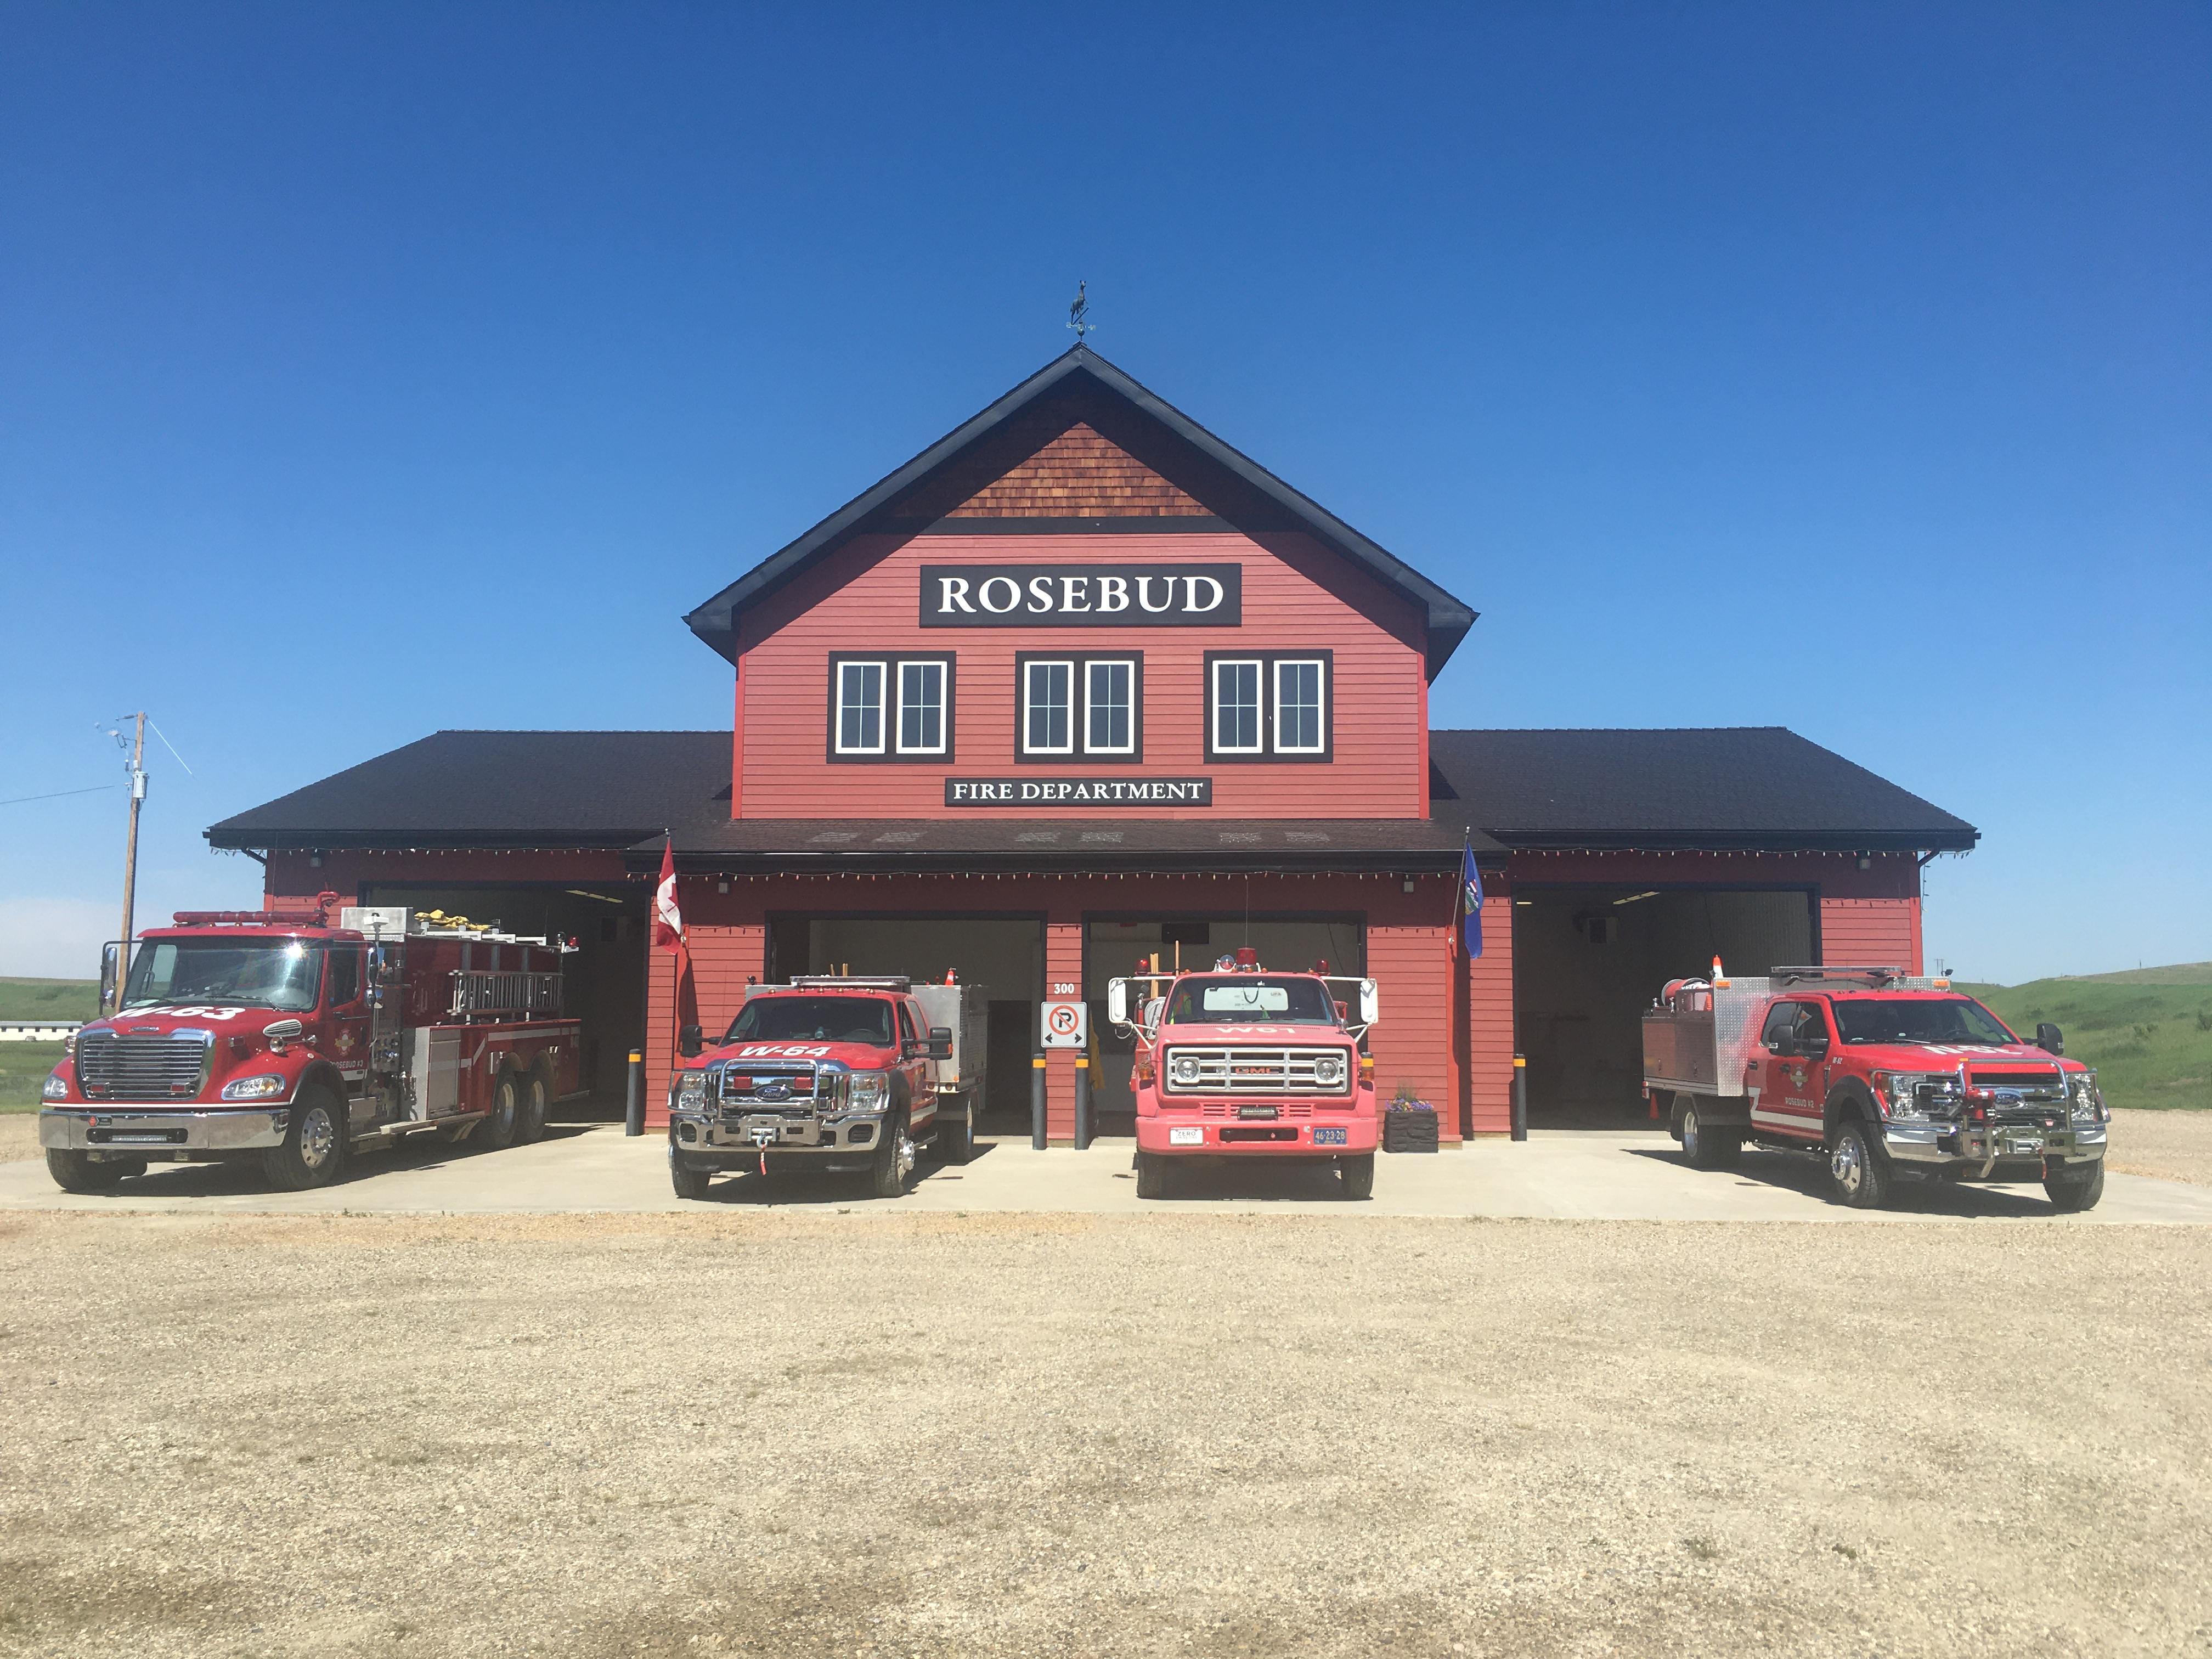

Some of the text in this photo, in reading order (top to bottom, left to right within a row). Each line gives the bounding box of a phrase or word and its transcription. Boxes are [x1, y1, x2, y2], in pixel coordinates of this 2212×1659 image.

[937, 576, 1223, 613] ROSEBUD
[953, 782, 1203, 799] FIRE DEPARTMENT
[1054, 983, 1074, 994] 300
[108, 1006, 246, 1020] W-63
[739, 1046, 832, 1057] W-64
[763, 1088, 782, 1097] Ford
[1785, 1097, 1807, 1107] ROSEBUD
